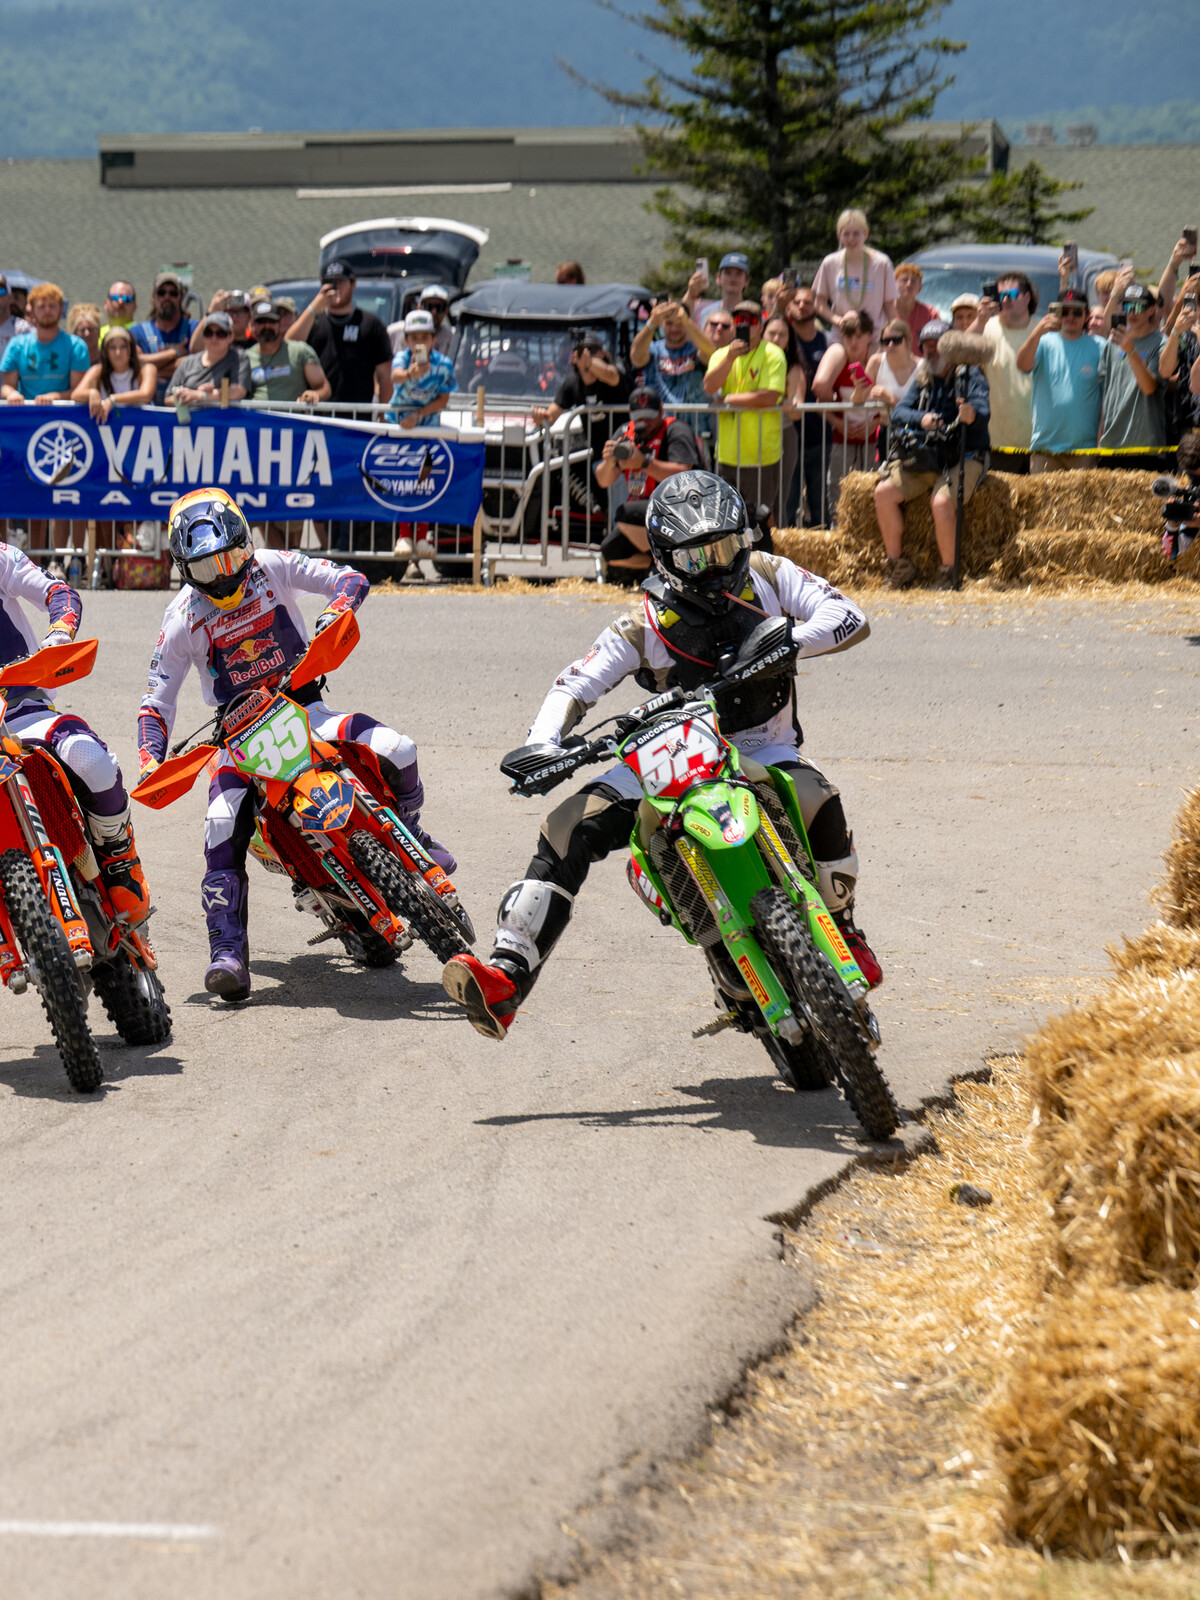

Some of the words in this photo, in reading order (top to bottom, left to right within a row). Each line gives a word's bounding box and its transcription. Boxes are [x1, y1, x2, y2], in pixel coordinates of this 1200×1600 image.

[99, 425, 333, 486] YAMAHA
[371, 444, 440, 455] BLU
[52, 490, 316, 508] RACNG
[229, 660, 259, 686] Red
[259, 649, 286, 672] Bull
[235, 750, 246, 761] 1
[248, 704, 308, 778] 35
[523, 758, 576, 785] ACERBIS
[816, 915, 852, 962] PIRELLI
[739, 954, 771, 1008] PIRELLI
